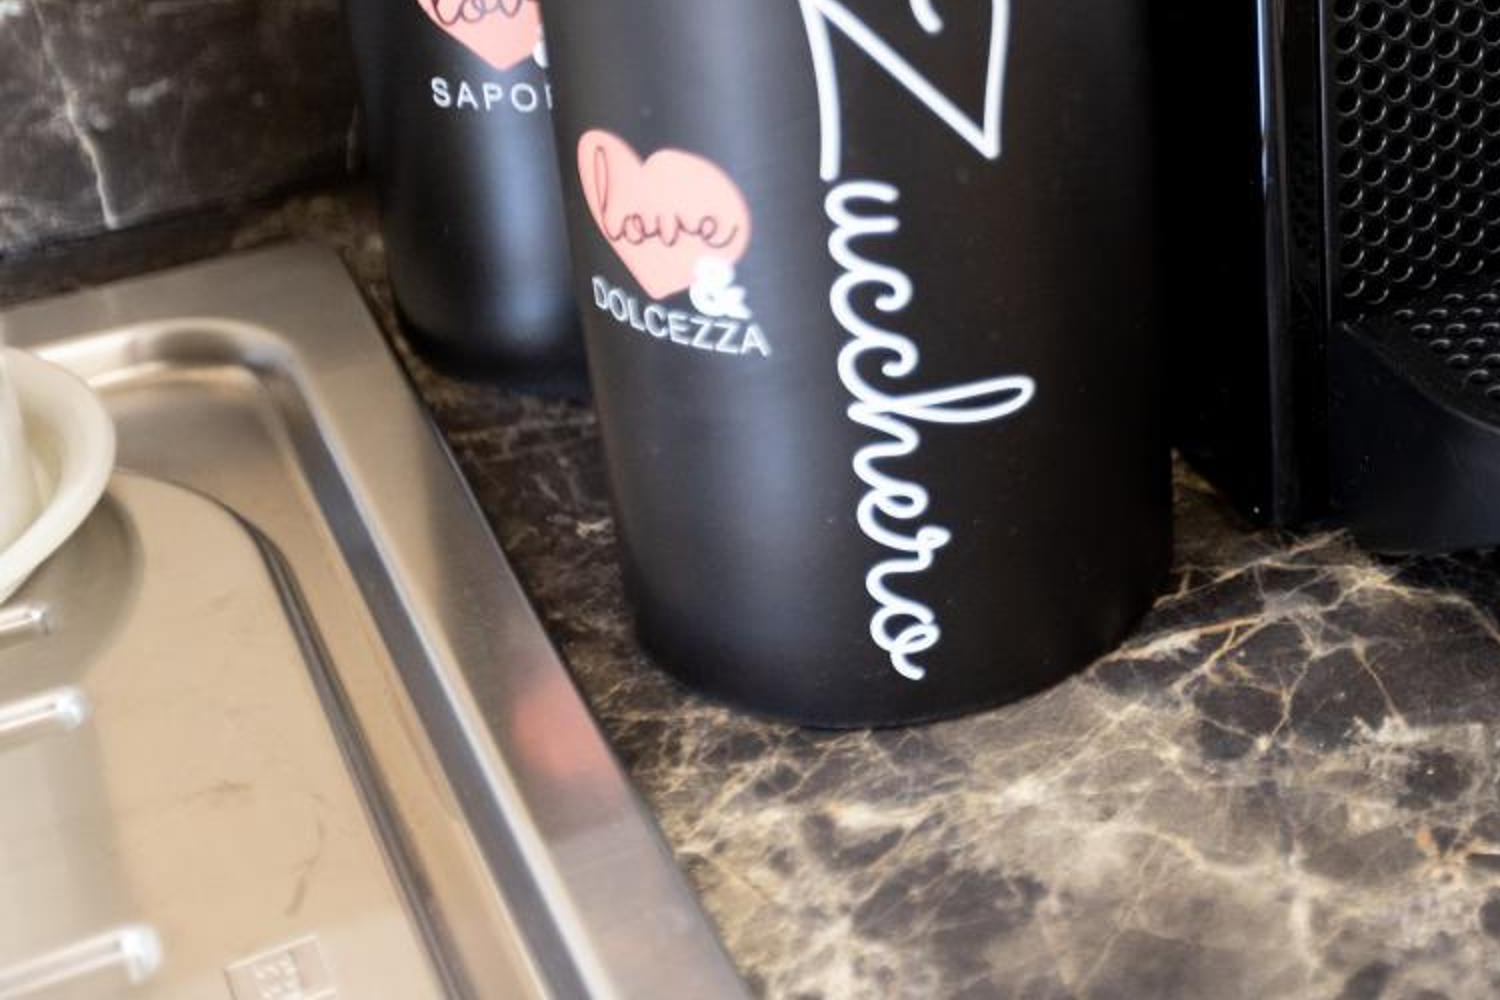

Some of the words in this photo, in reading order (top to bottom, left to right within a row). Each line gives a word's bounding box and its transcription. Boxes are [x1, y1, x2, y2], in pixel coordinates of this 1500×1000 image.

[595, 145, 739, 249] love
[590, 275, 772, 357] DOLCEZZA
[689, 254, 752, 320] &
